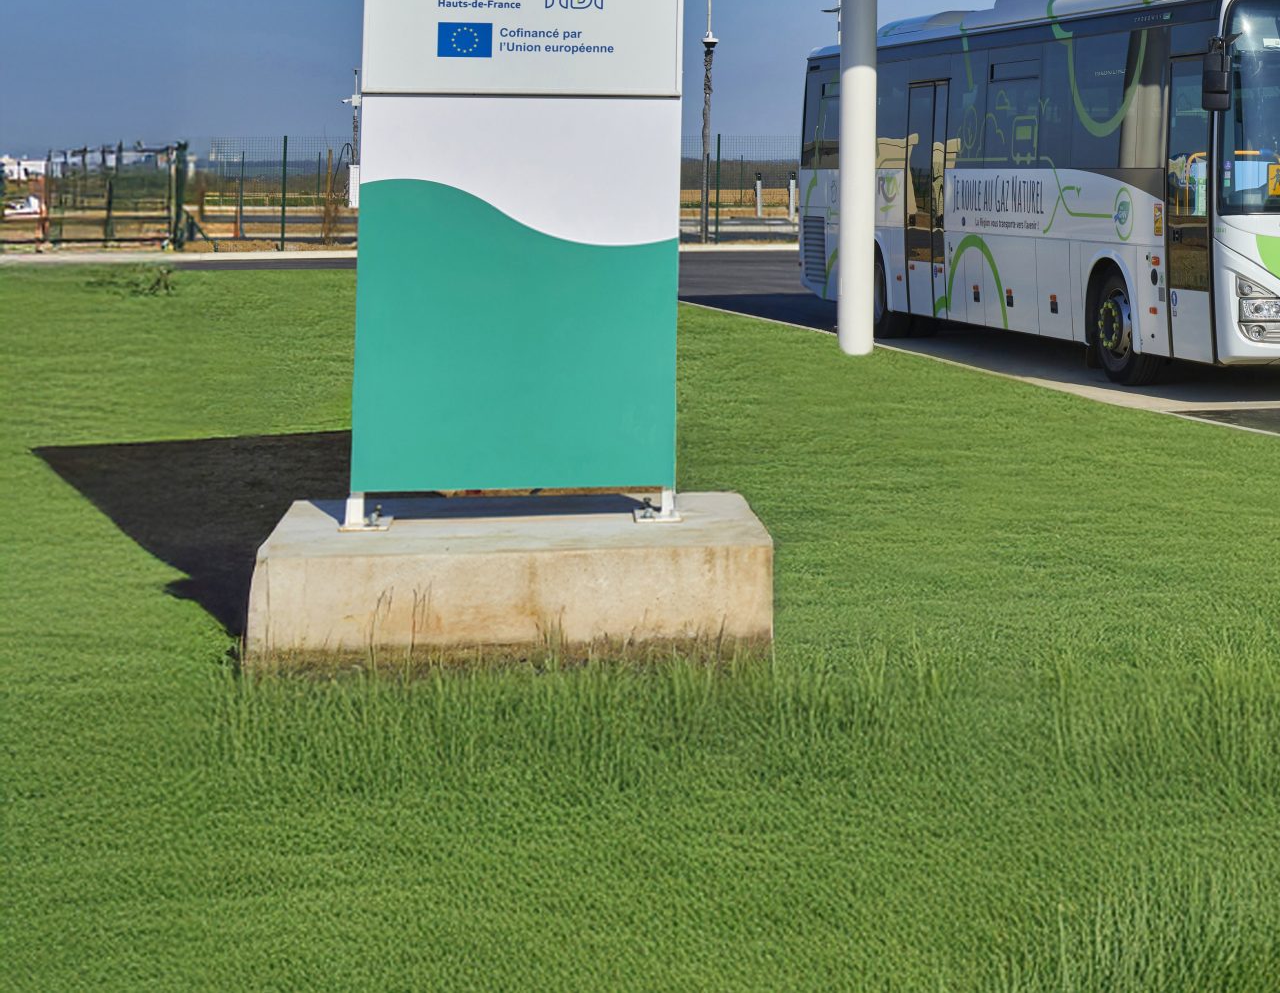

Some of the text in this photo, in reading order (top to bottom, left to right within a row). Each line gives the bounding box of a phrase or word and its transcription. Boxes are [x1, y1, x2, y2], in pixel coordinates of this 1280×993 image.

[438, 0, 521, 9] Hauts-de-France
[499, 27, 583, 41] Cofinancé par
[499, 41, 615, 55] l'Union européenne
[953, 175, 1044, 214] JE ROULE AU GAZ NATUREL
